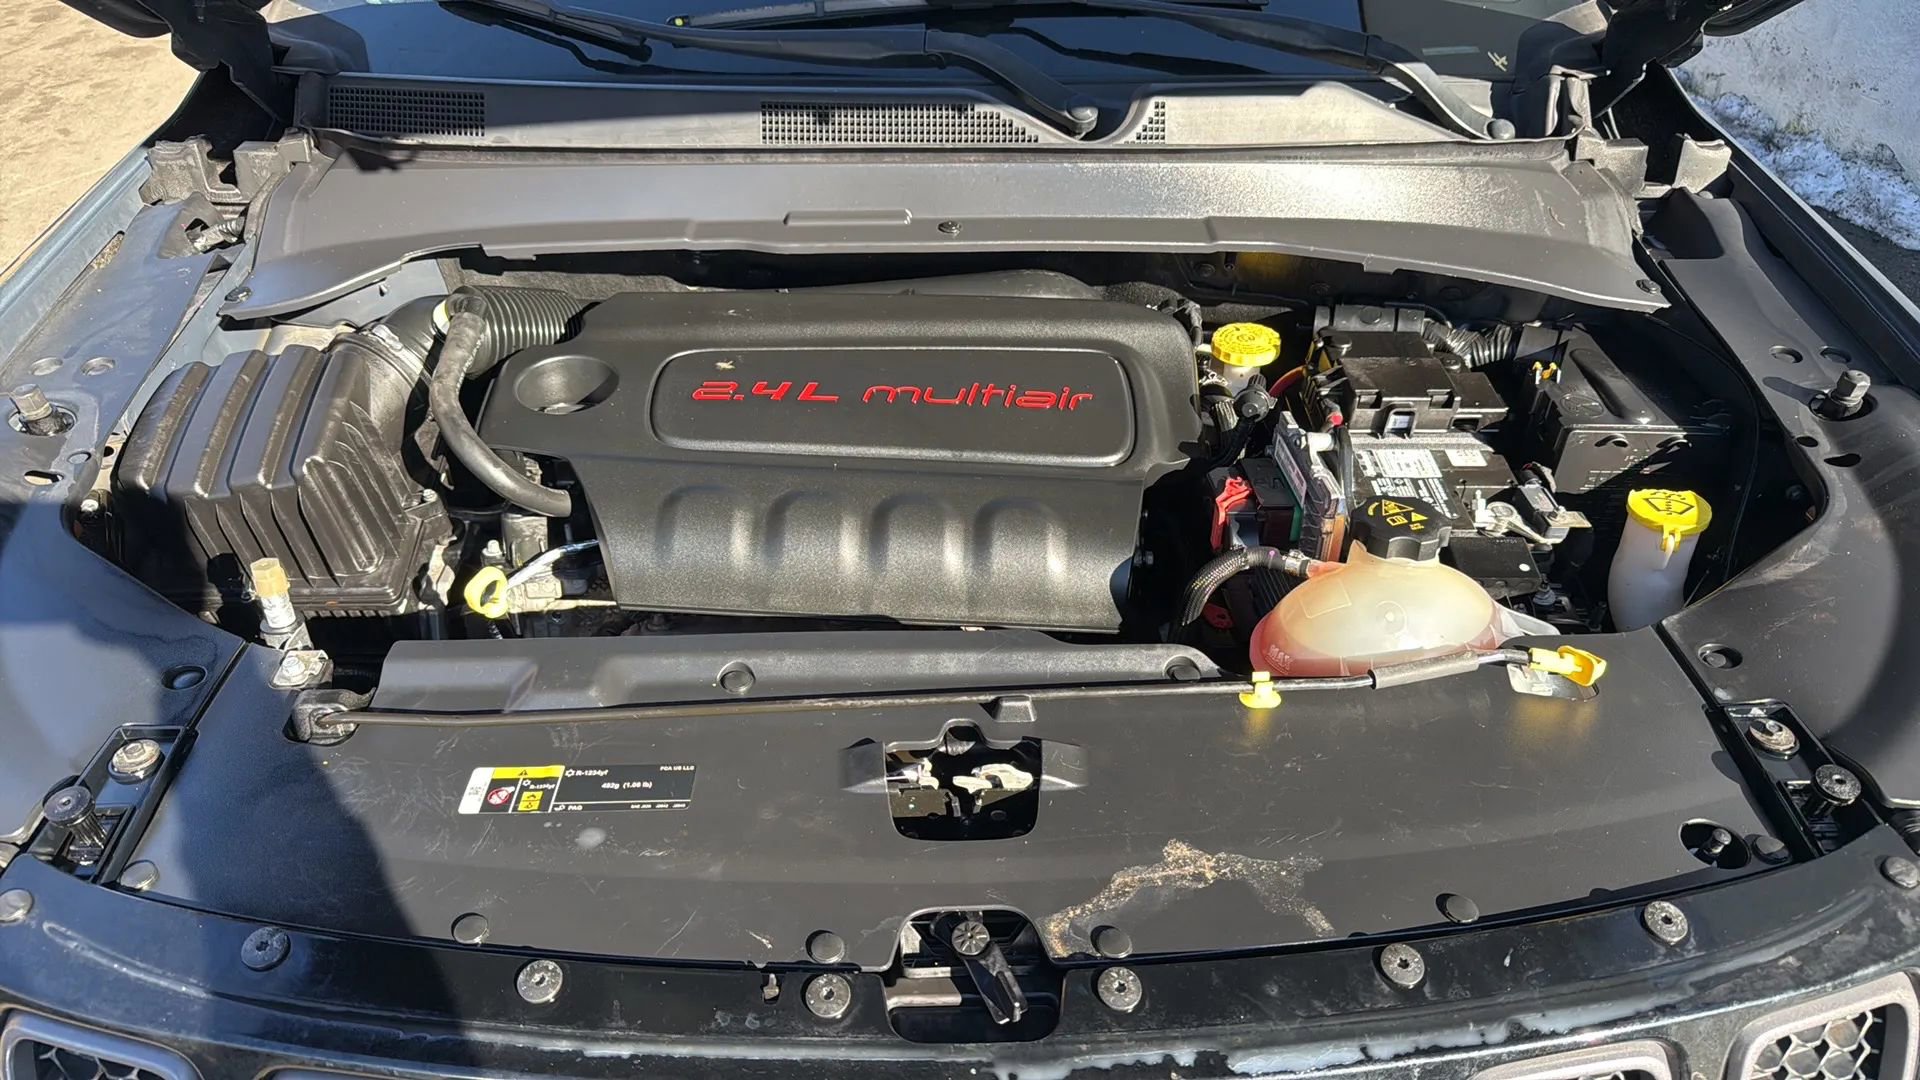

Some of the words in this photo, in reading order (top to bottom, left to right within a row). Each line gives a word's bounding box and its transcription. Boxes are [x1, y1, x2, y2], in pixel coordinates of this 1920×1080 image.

[862, 382, 1094, 411] multiair
[1270, 644, 1293, 669] MAX
[575, 769, 609, 777] R-1234yf
